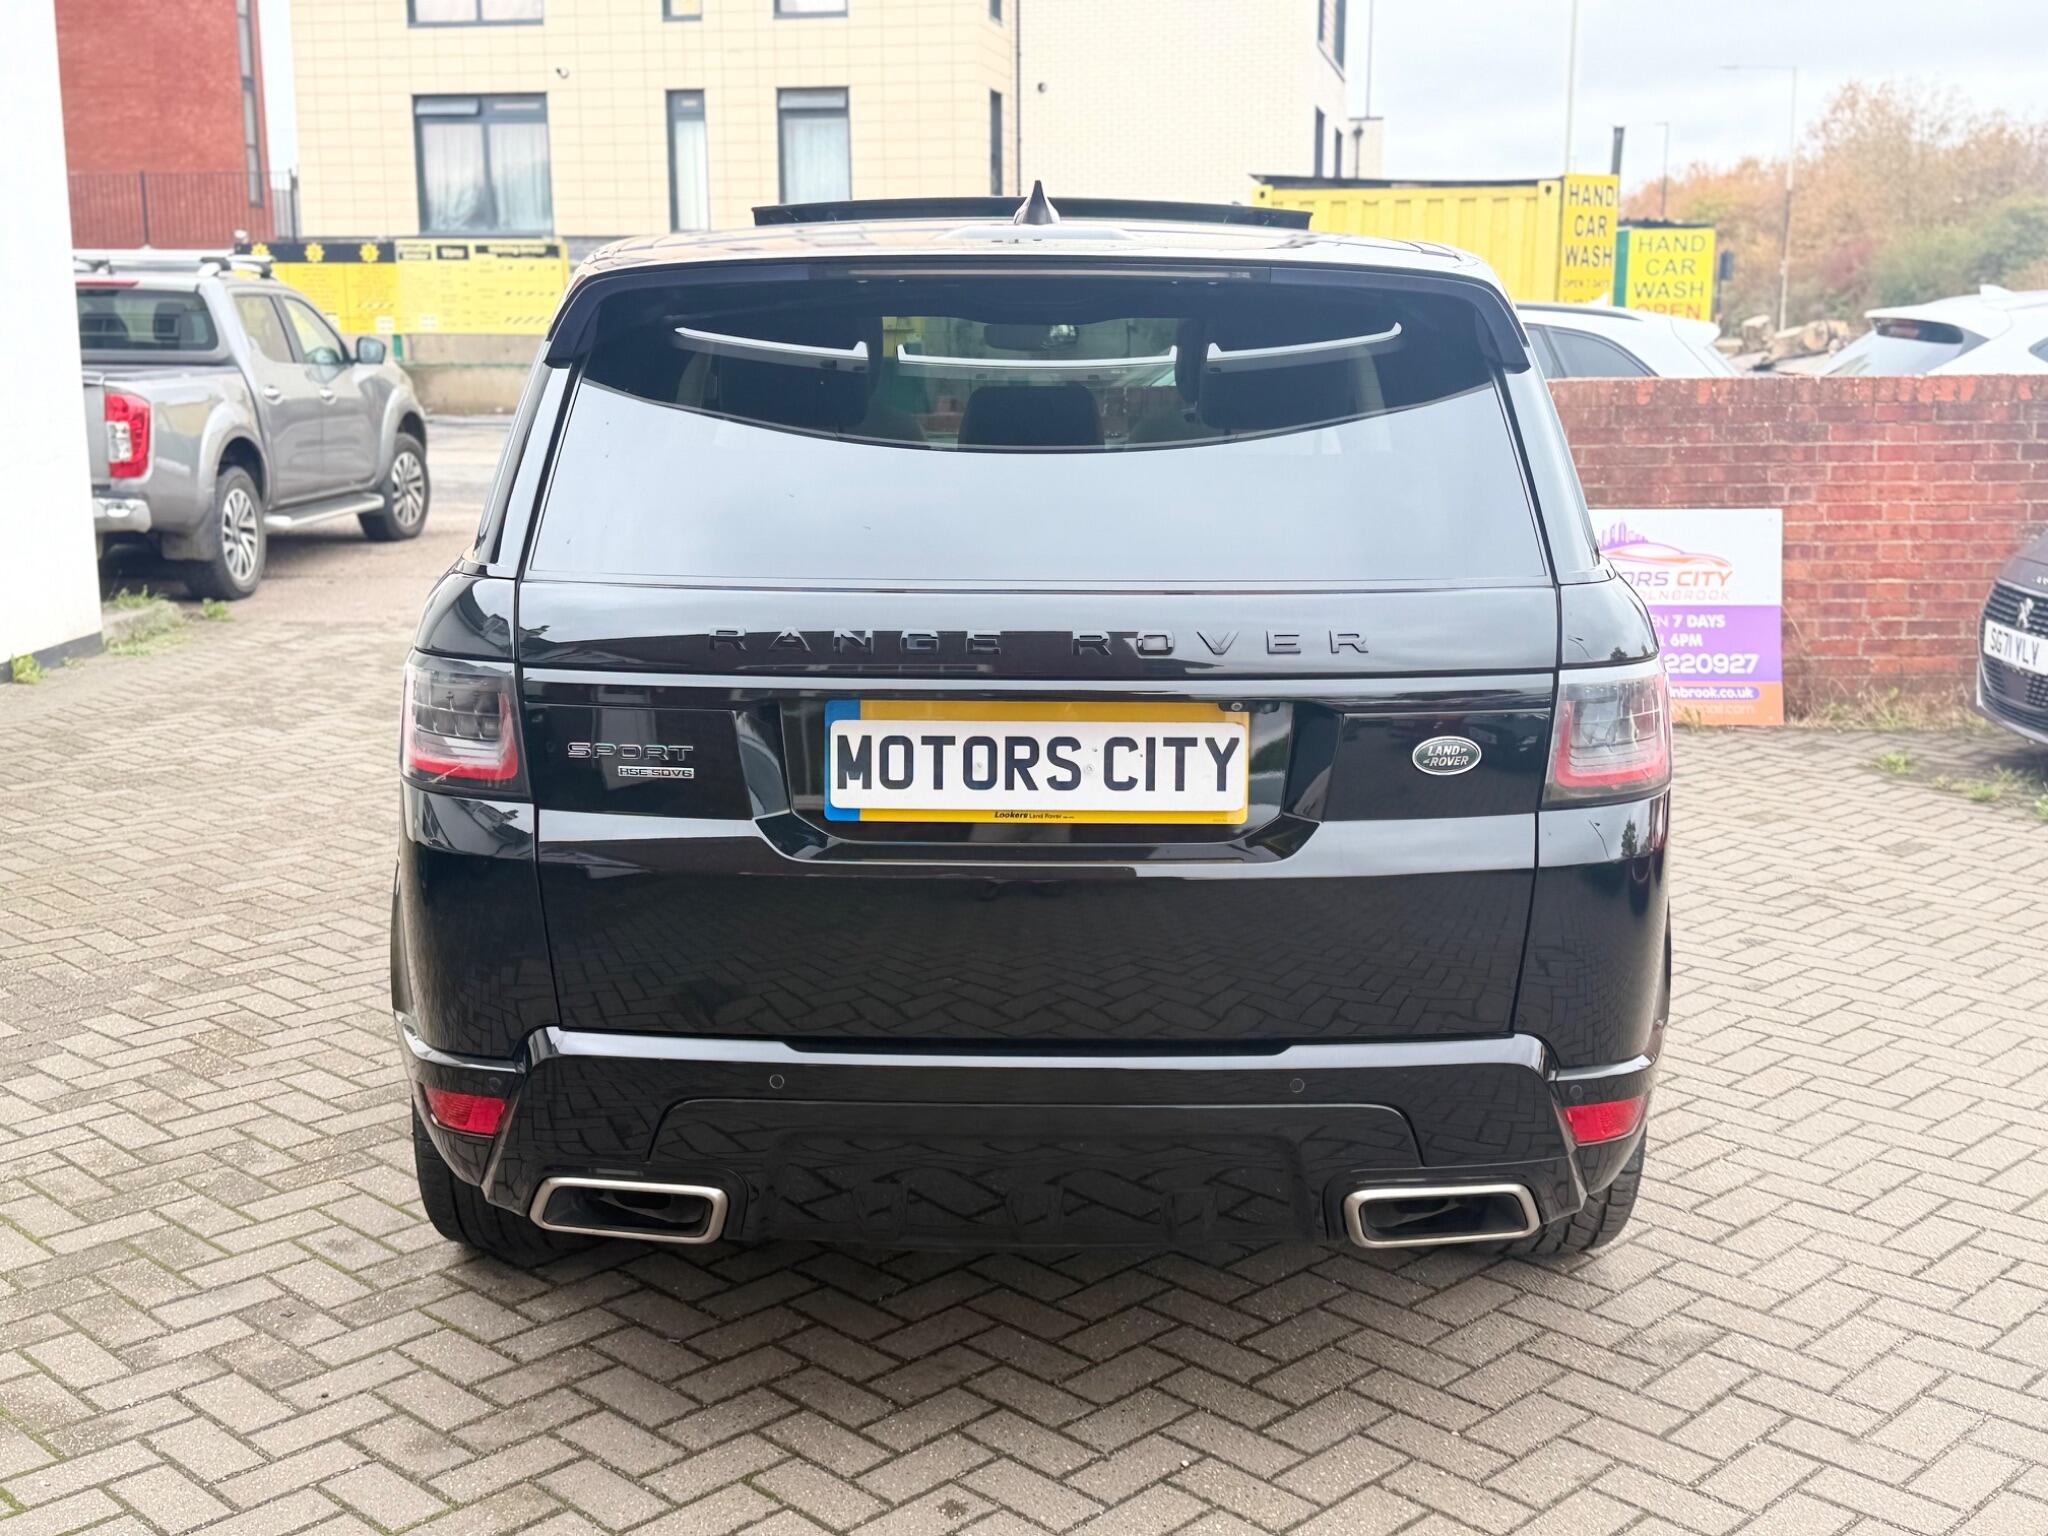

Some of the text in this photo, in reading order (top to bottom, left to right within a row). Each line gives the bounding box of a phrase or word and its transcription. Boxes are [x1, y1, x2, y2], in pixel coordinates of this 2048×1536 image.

[1568, 183, 1614, 207] HAND
[1575, 214, 1607, 237] CAR
[1638, 235, 1706, 252] HAND
[1565, 245, 1612, 268] WASH
[1646, 258, 1696, 276] CAR
[1633, 281, 1704, 299] WASH
[1676, 571, 1733, 587] CITY
[1672, 614, 1683, 628] 7
[1687, 614, 1726, 628] DAYS
[708, 627, 1370, 655] RANGE ROVER
[1670, 633, 1704, 648] 6PM
[1663, 653, 1759, 674] 220927
[567, 742, 694, 761] SPORT
[1428, 746, 1460, 756] LAND
[837, 735, 1240, 792] MOTORS CITY
[1429, 756, 1469, 767] ROVER
[619, 767, 693, 778] HSE SDV6
[995, 810, 1027, 819] Lookers
